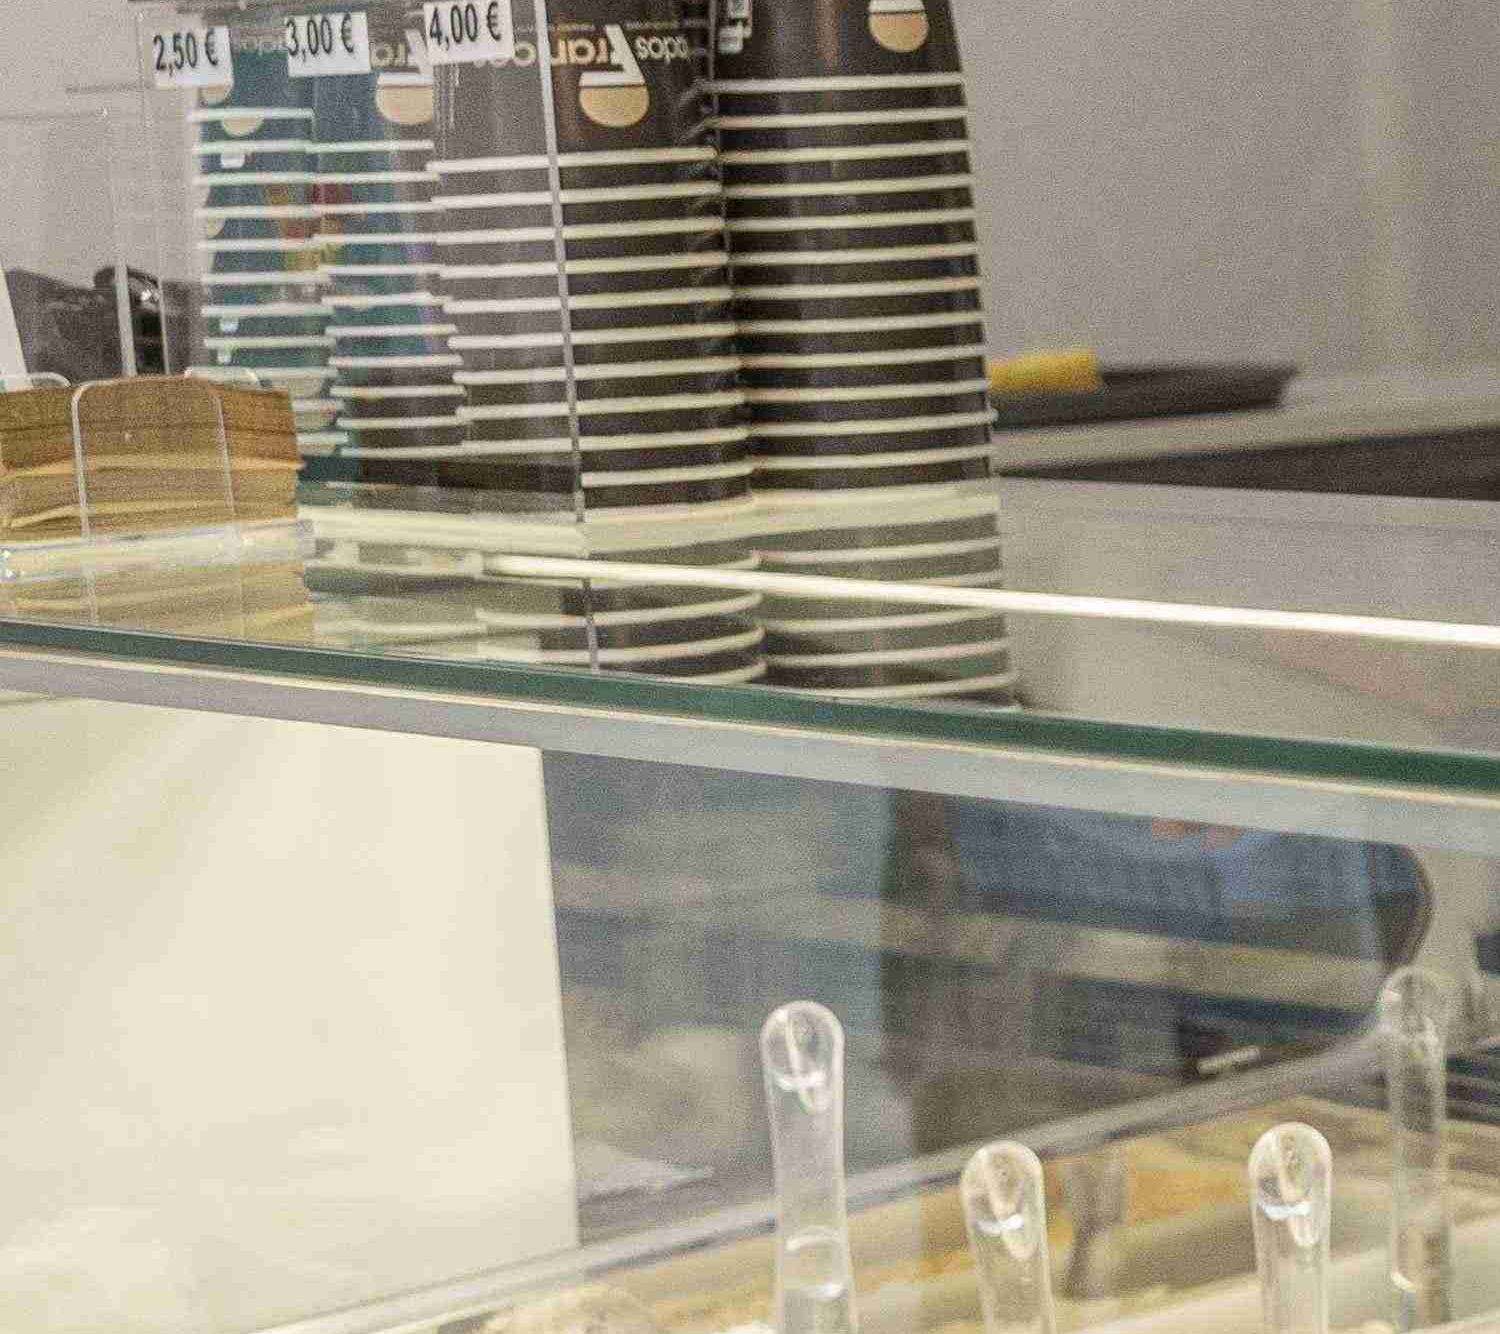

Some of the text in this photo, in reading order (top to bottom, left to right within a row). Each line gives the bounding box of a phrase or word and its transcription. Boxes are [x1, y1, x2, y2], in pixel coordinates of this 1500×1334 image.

[286, 17, 333, 62] 3,00
[340, 15, 355, 53] €
[429, 4, 501, 48] 4,00 €
[153, 31, 197, 76] 2,50
[203, 30, 219, 67] €
